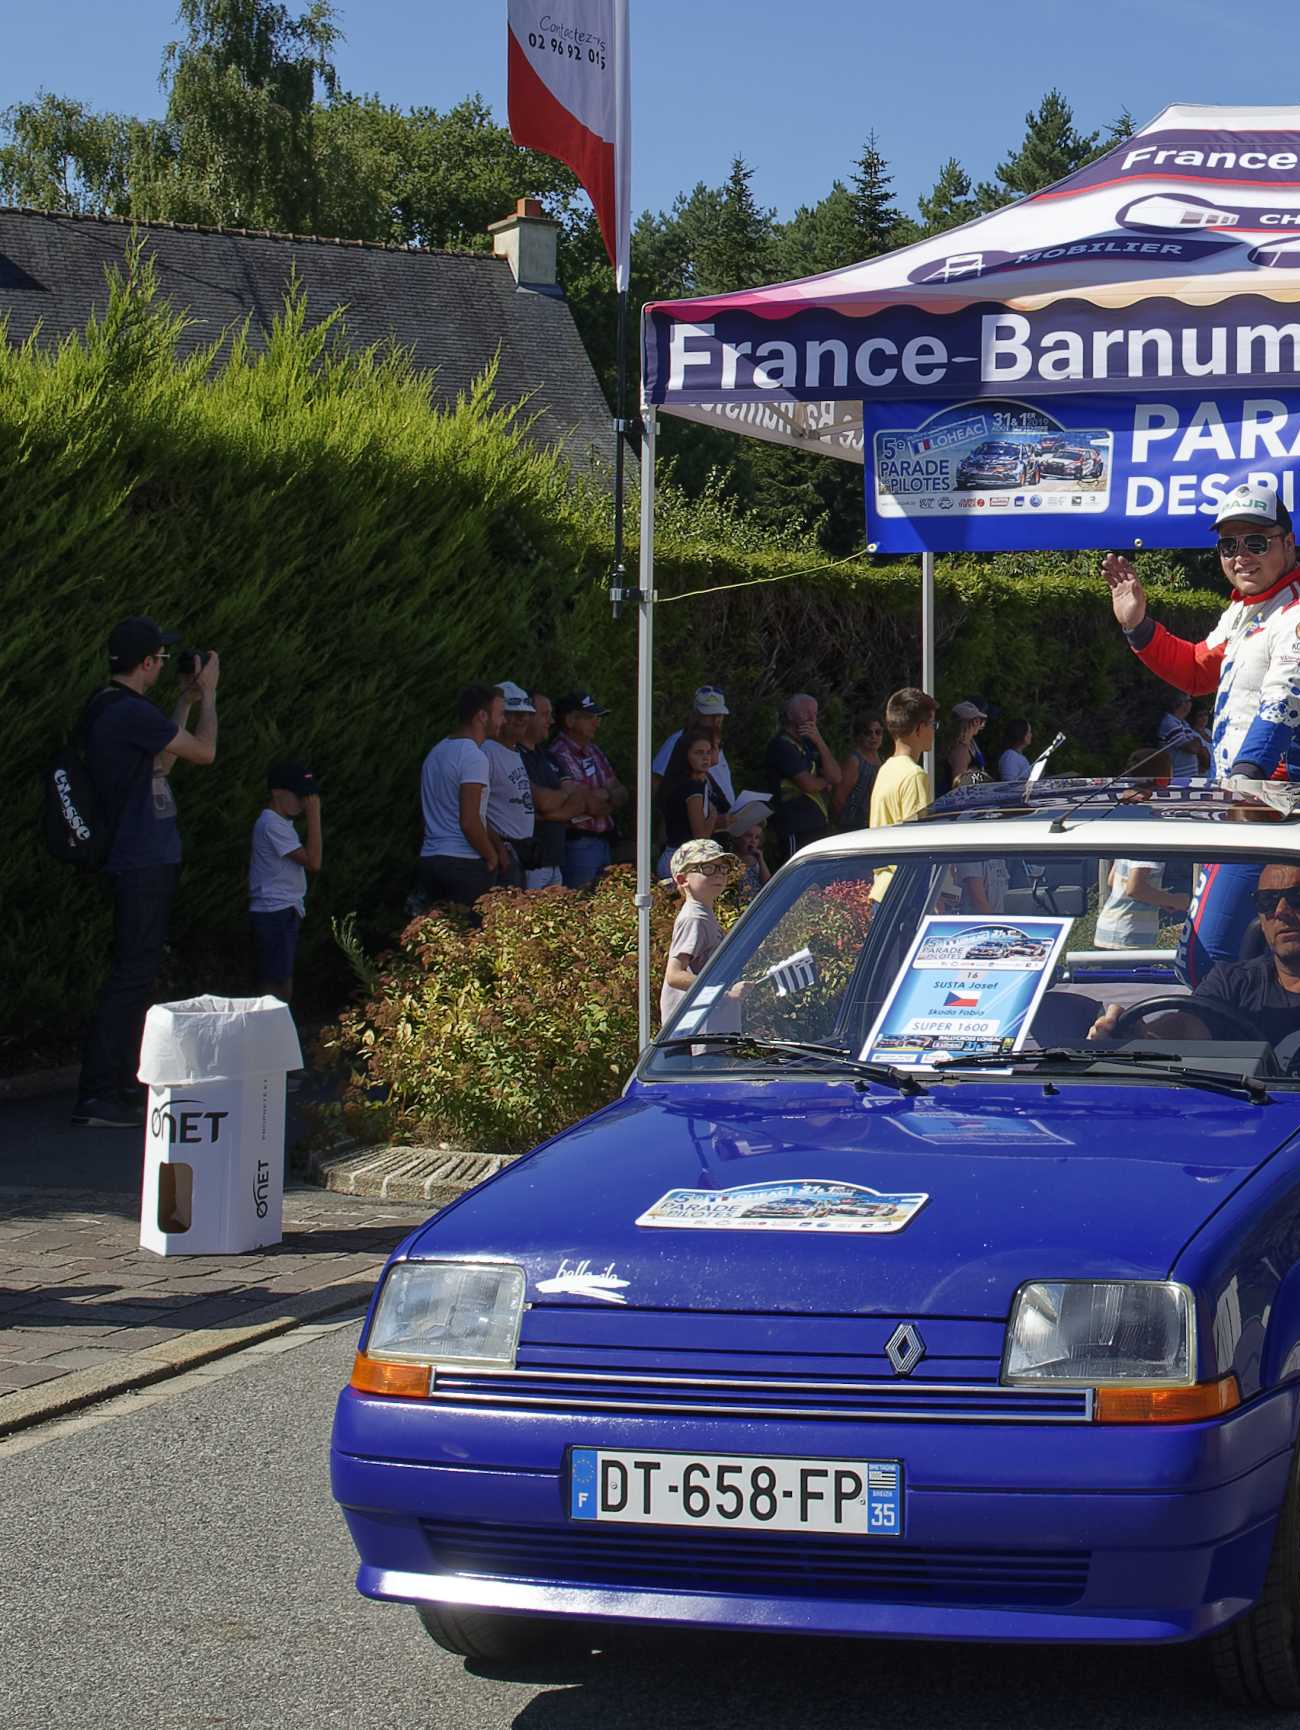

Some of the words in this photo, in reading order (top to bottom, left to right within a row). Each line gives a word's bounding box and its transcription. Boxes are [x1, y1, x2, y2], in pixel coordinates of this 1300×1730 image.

[528, 33, 545, 49] 02
[551, 38, 564, 55] 96
[567, 44, 582, 60] 92
[1014, 241, 1183, 264] MOBILIER
[931, 423, 984, 449] LOHEAC
[881, 460, 950, 477] PARADE
[891, 477, 950, 492] PILOTES
[1125, 473, 1230, 516] DES
[933, 981, 966, 989] SUSTA
[912, 1022, 953, 1032] SUPER
[957, 1023, 989, 1033] 1600
[578, 1493, 589, 1508] F
[601, 1459, 863, 1524] DT-658-FP
[871, 1503, 896, 1527] 35
